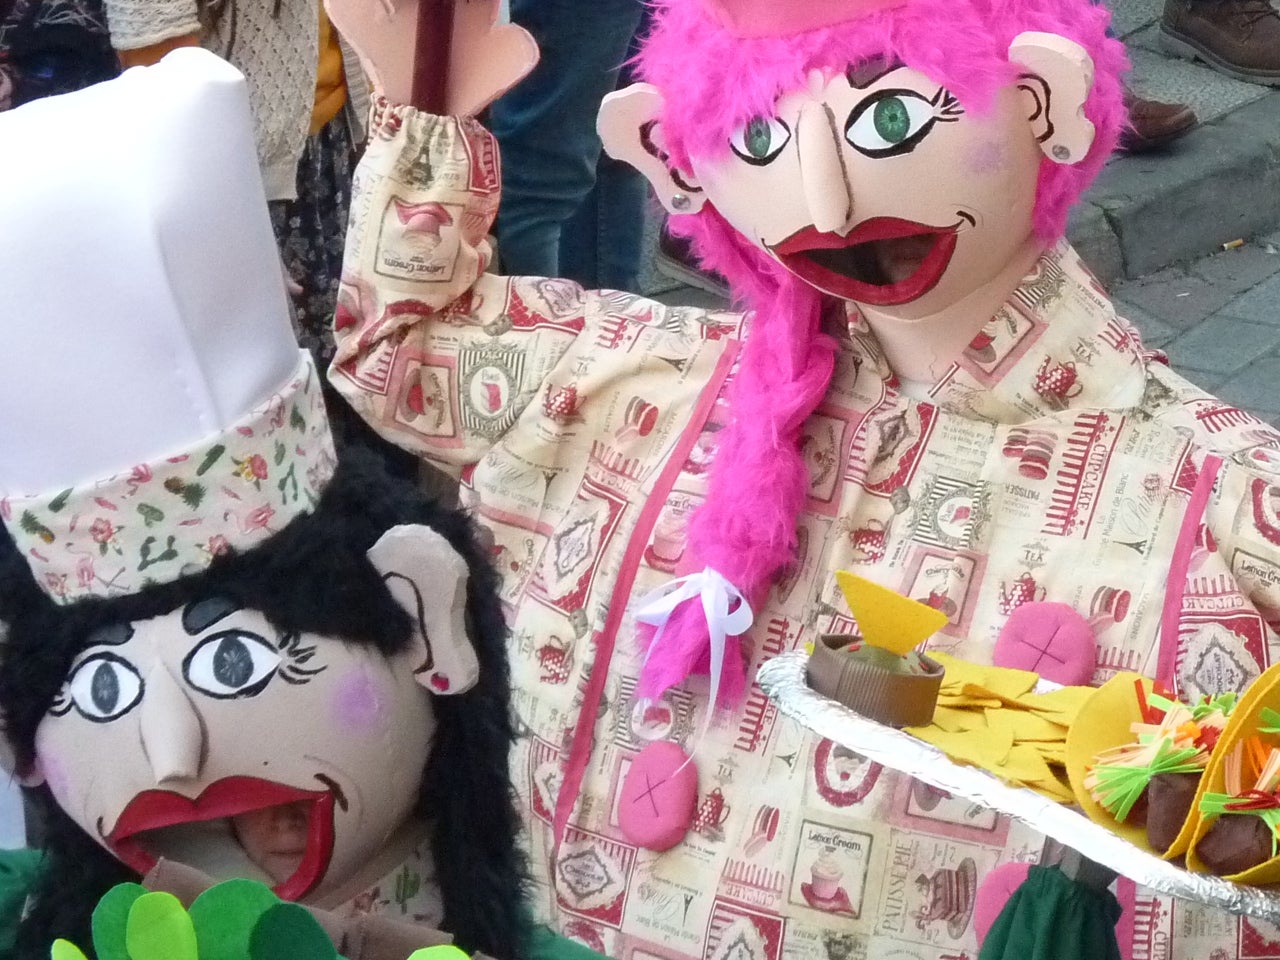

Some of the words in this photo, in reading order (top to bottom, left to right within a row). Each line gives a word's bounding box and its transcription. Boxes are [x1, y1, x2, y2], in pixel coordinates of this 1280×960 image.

[1077, 443, 1108, 512] CUPCAKE
[1115, 472, 1129, 494] Blanc
[1024, 549, 1043, 563] TEA
[1240, 558, 1268, 580] Lemon
[1184, 595, 1245, 611] CUPCAK
[832, 834, 862, 852] Cream
[881, 839, 913, 933] PATISSERIE
